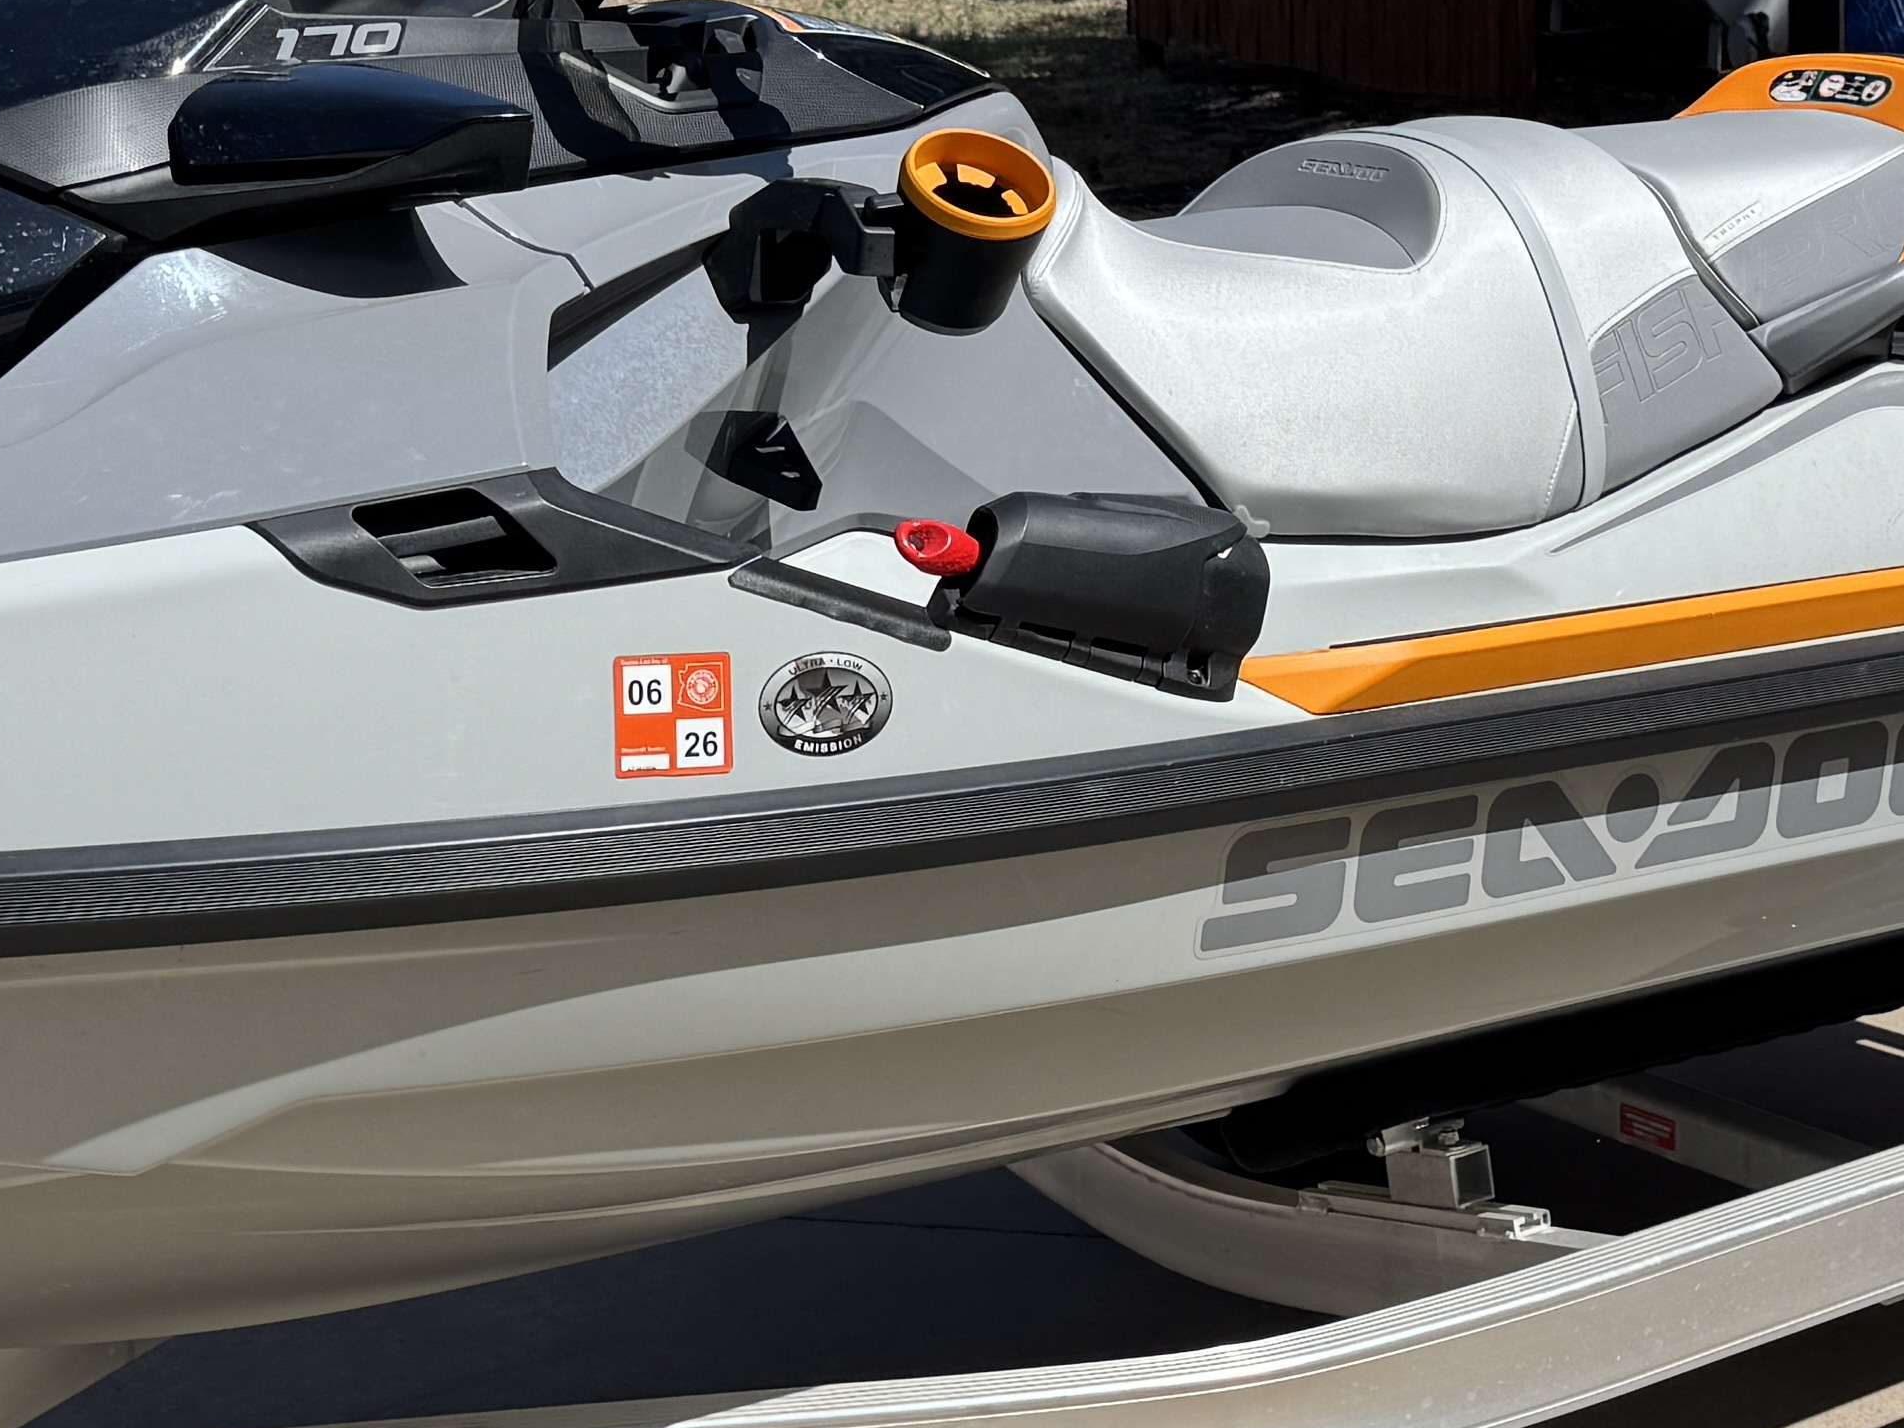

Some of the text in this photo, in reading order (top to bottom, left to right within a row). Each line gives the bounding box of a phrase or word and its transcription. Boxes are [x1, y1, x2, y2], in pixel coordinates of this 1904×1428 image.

[275, 21, 402, 61] 170
[788, 657, 863, 675] ULTRA LOW
[628, 678, 662, 706] 06
[684, 730, 719, 758] 26
[793, 733, 863, 754] EMISSION
